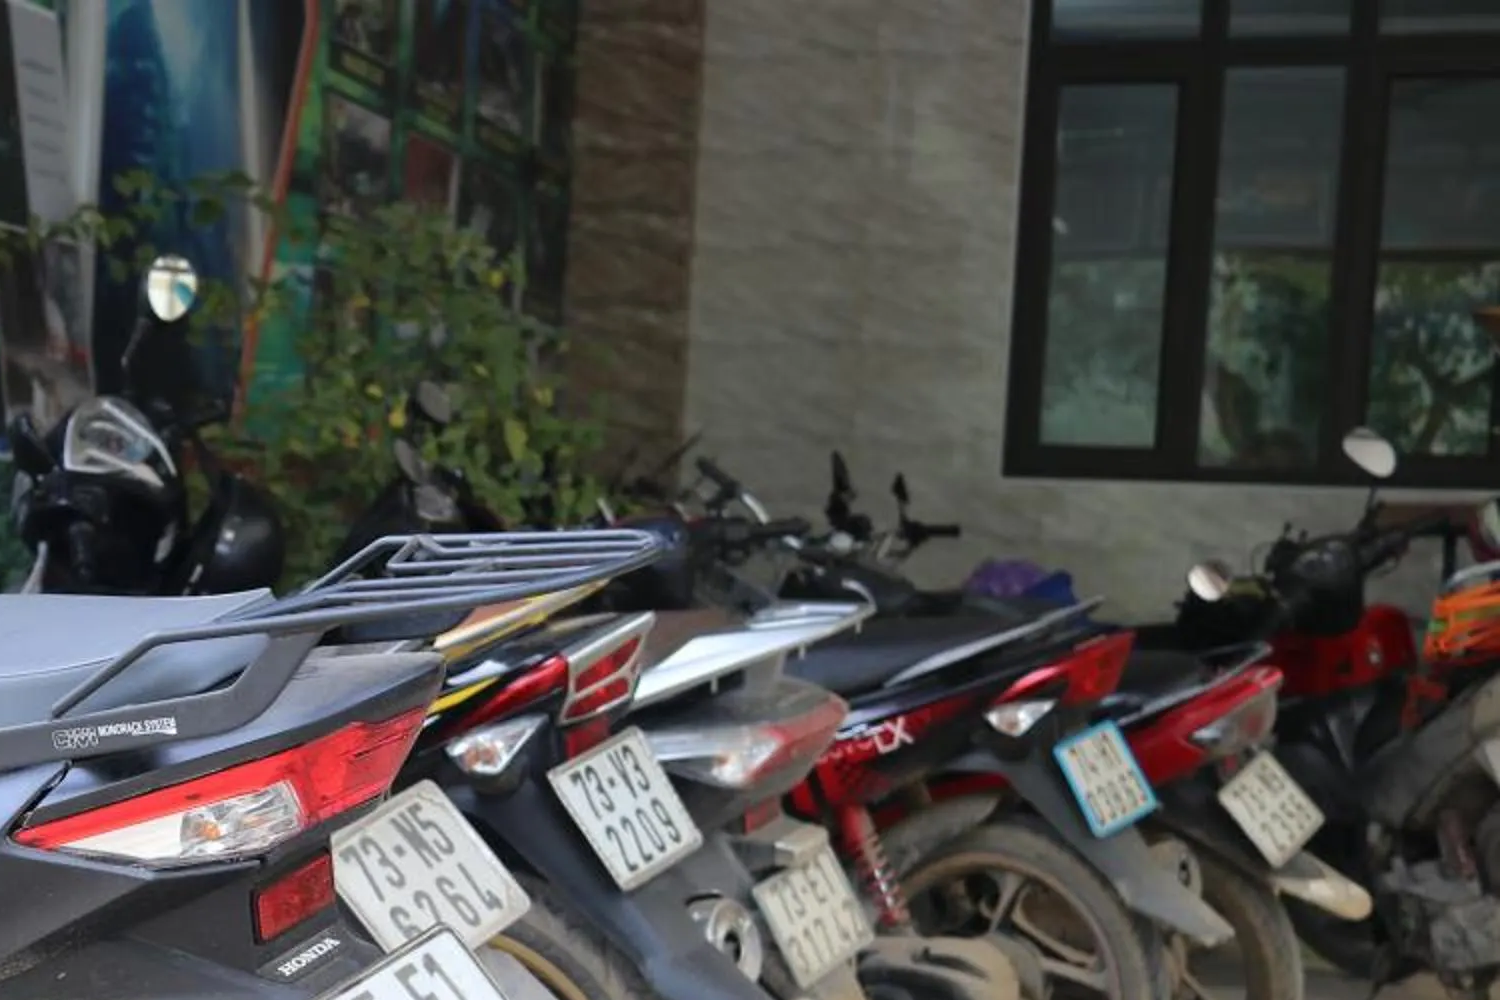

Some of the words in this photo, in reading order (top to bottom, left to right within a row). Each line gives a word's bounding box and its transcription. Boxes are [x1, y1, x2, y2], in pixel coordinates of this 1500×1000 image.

[569, 744, 651, 820] 73-V3
[338, 802, 456, 904] 73-N5
[605, 797, 681, 873] 2209
[277, 937, 341, 977] HONDA
